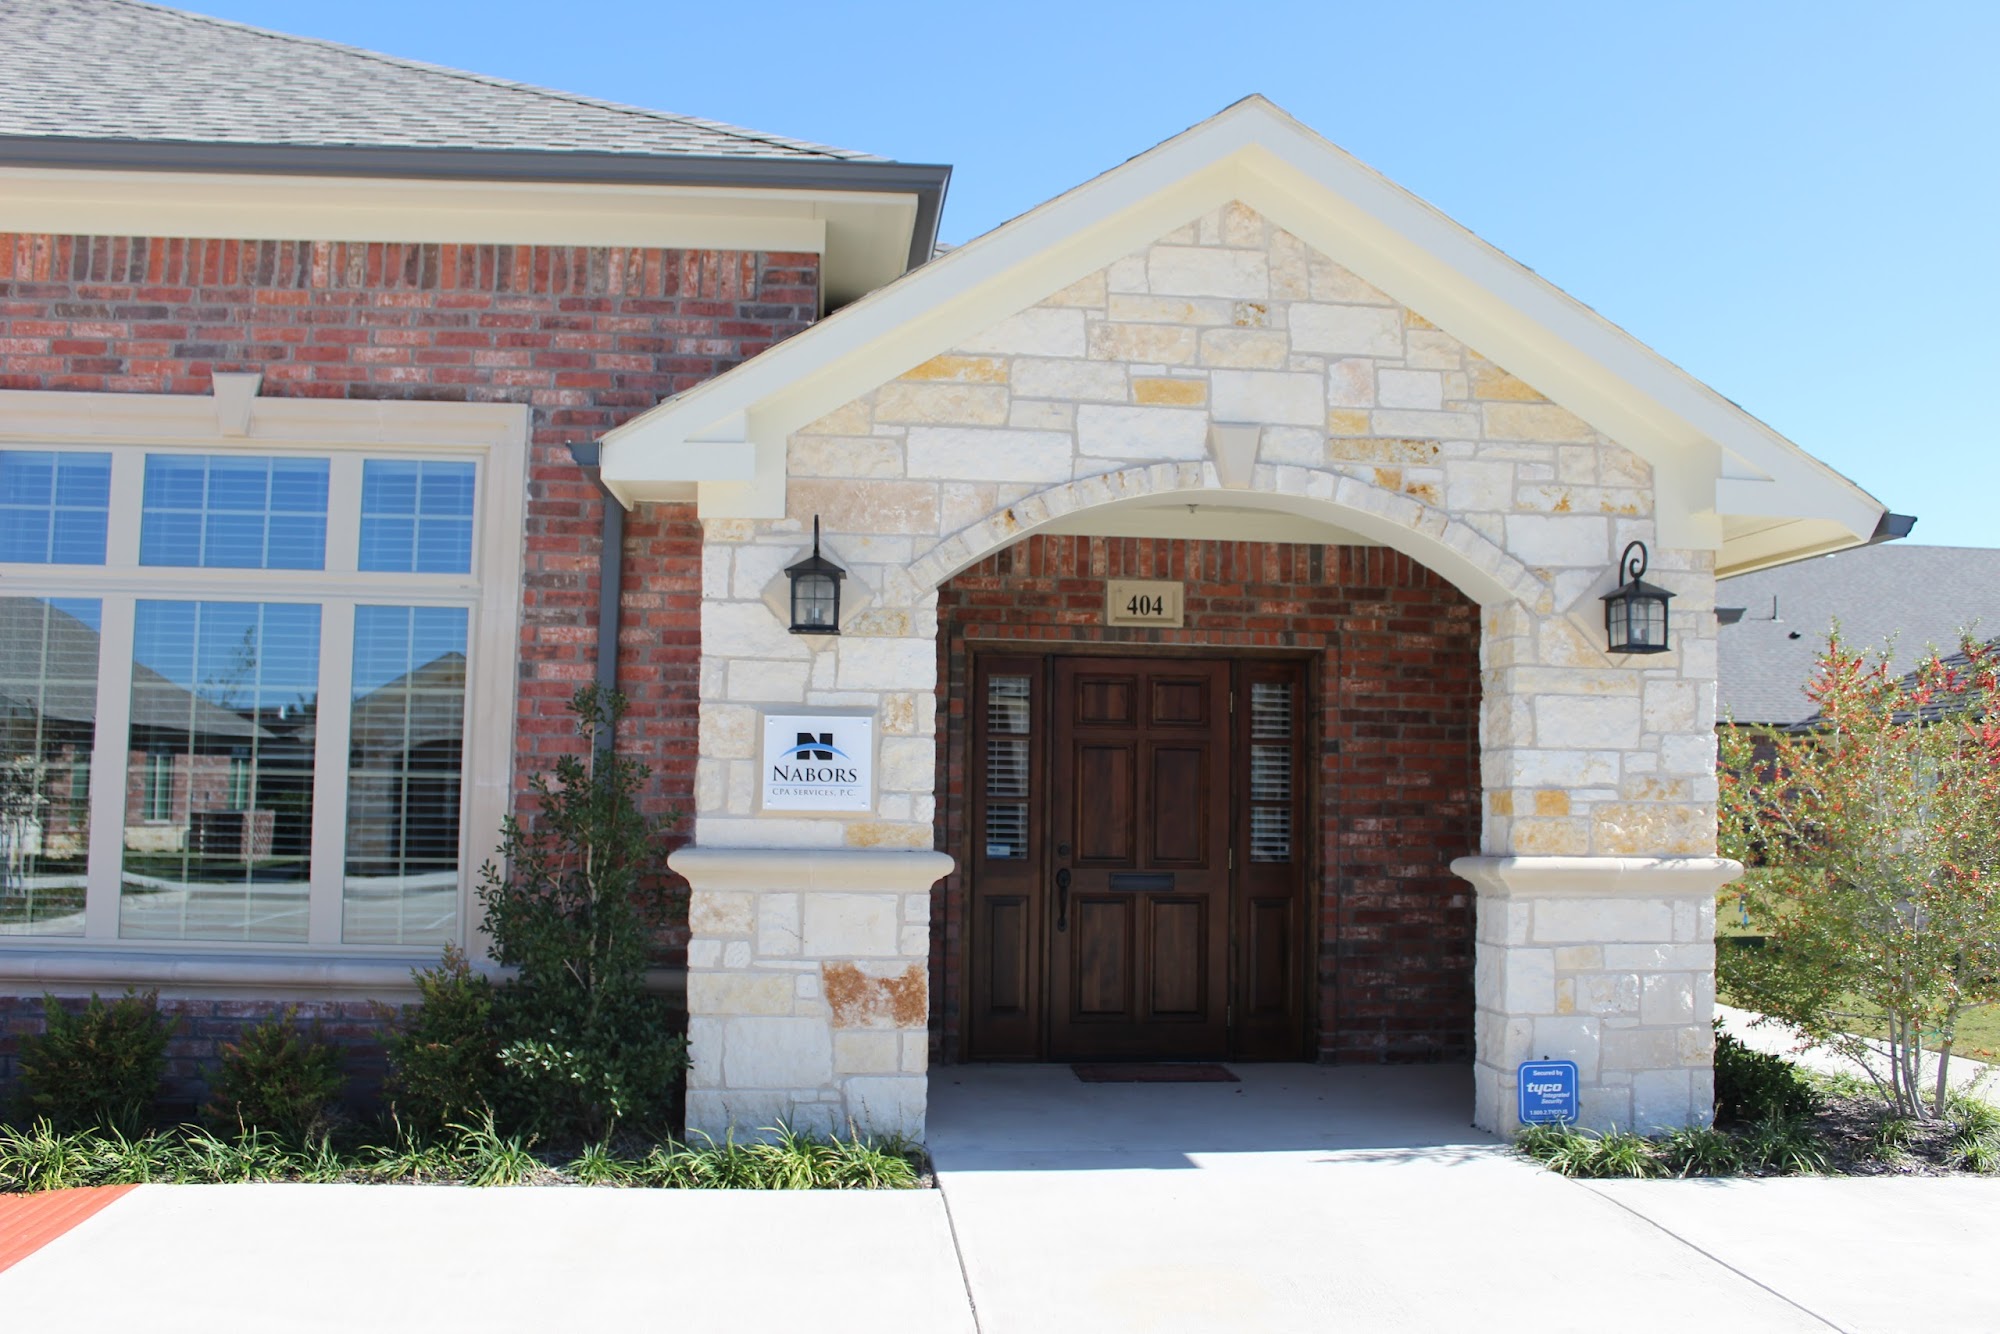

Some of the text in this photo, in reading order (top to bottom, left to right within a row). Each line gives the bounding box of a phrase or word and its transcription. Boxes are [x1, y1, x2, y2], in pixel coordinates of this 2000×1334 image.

[1127, 595, 1163, 615] 404
[773, 765, 857, 782] NABORS
[840, 789, 856, 797] P.C.
[1526, 1082, 1562, 1095] tyco
